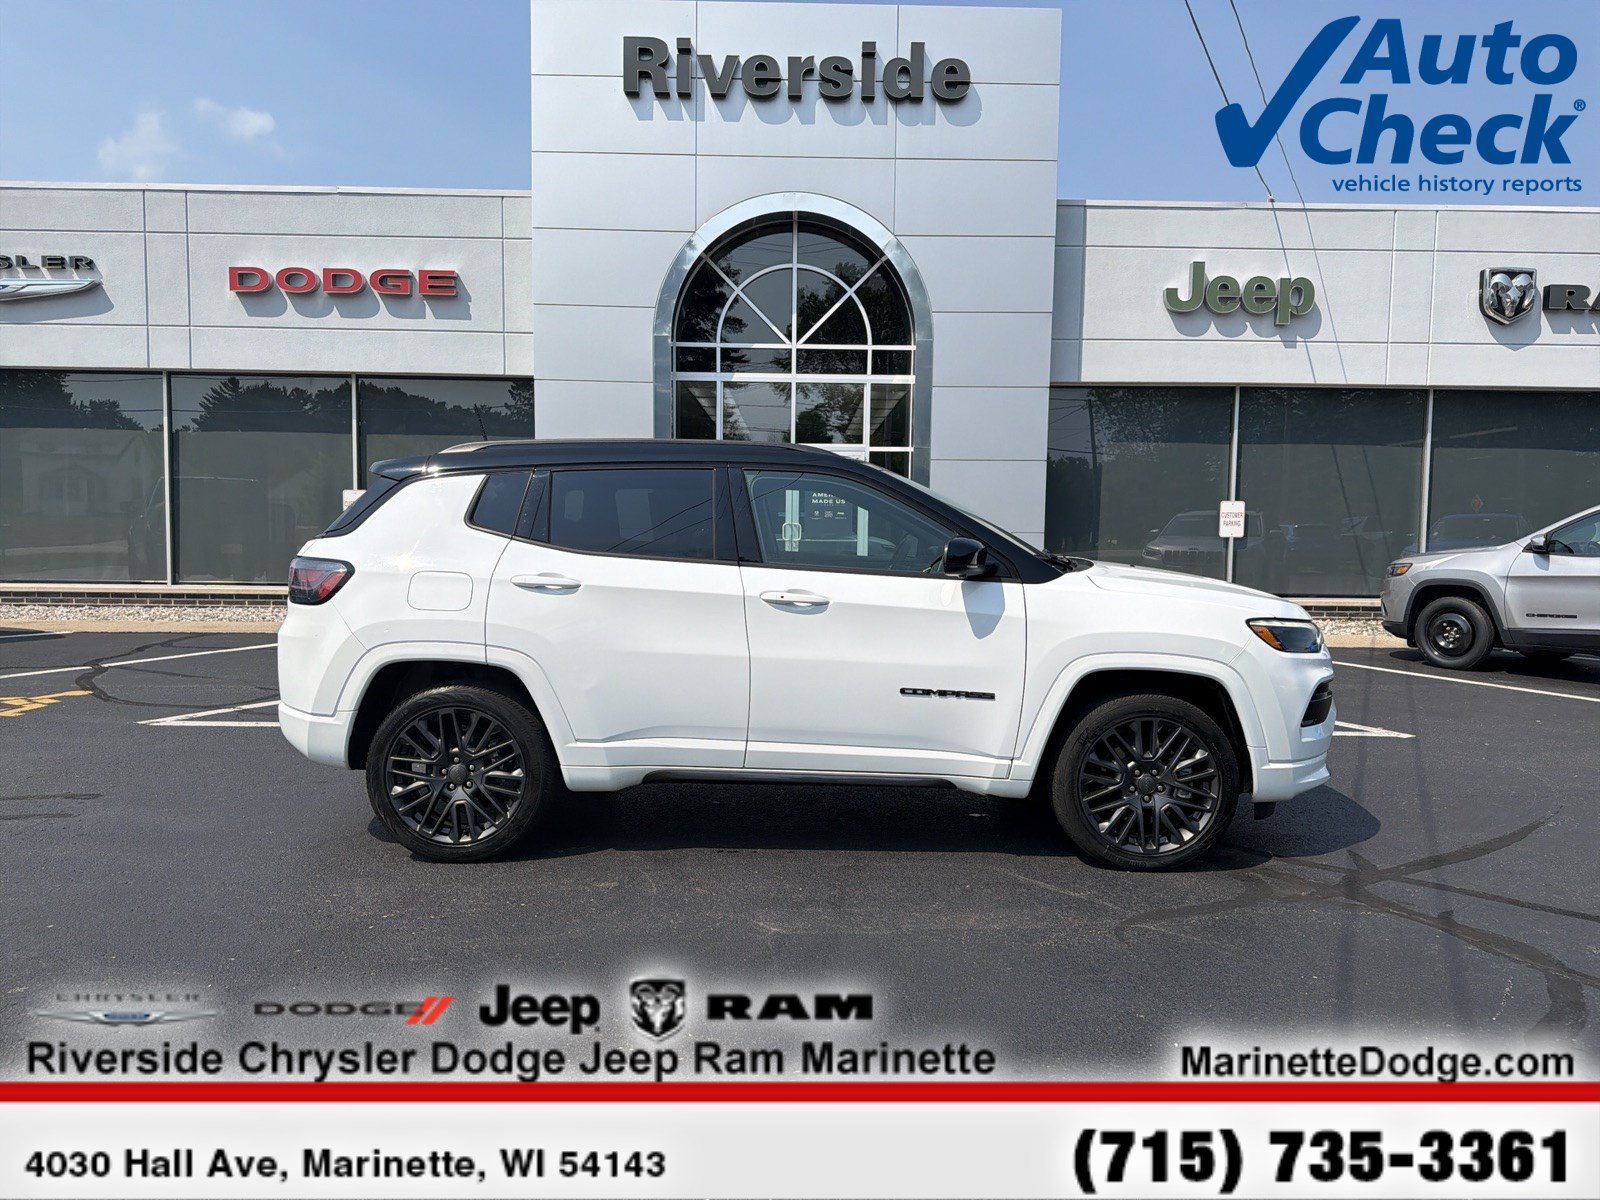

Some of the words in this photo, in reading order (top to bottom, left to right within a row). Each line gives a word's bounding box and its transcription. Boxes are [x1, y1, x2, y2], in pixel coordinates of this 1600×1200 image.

[623, 36, 971, 103] Riverside
[228, 266, 458, 297] DODGE
[1163, 261, 1315, 326] Jeep
[1221, 511, 1244, 519] CUSTOMER
[899, 687, 995, 700] COMPASS
